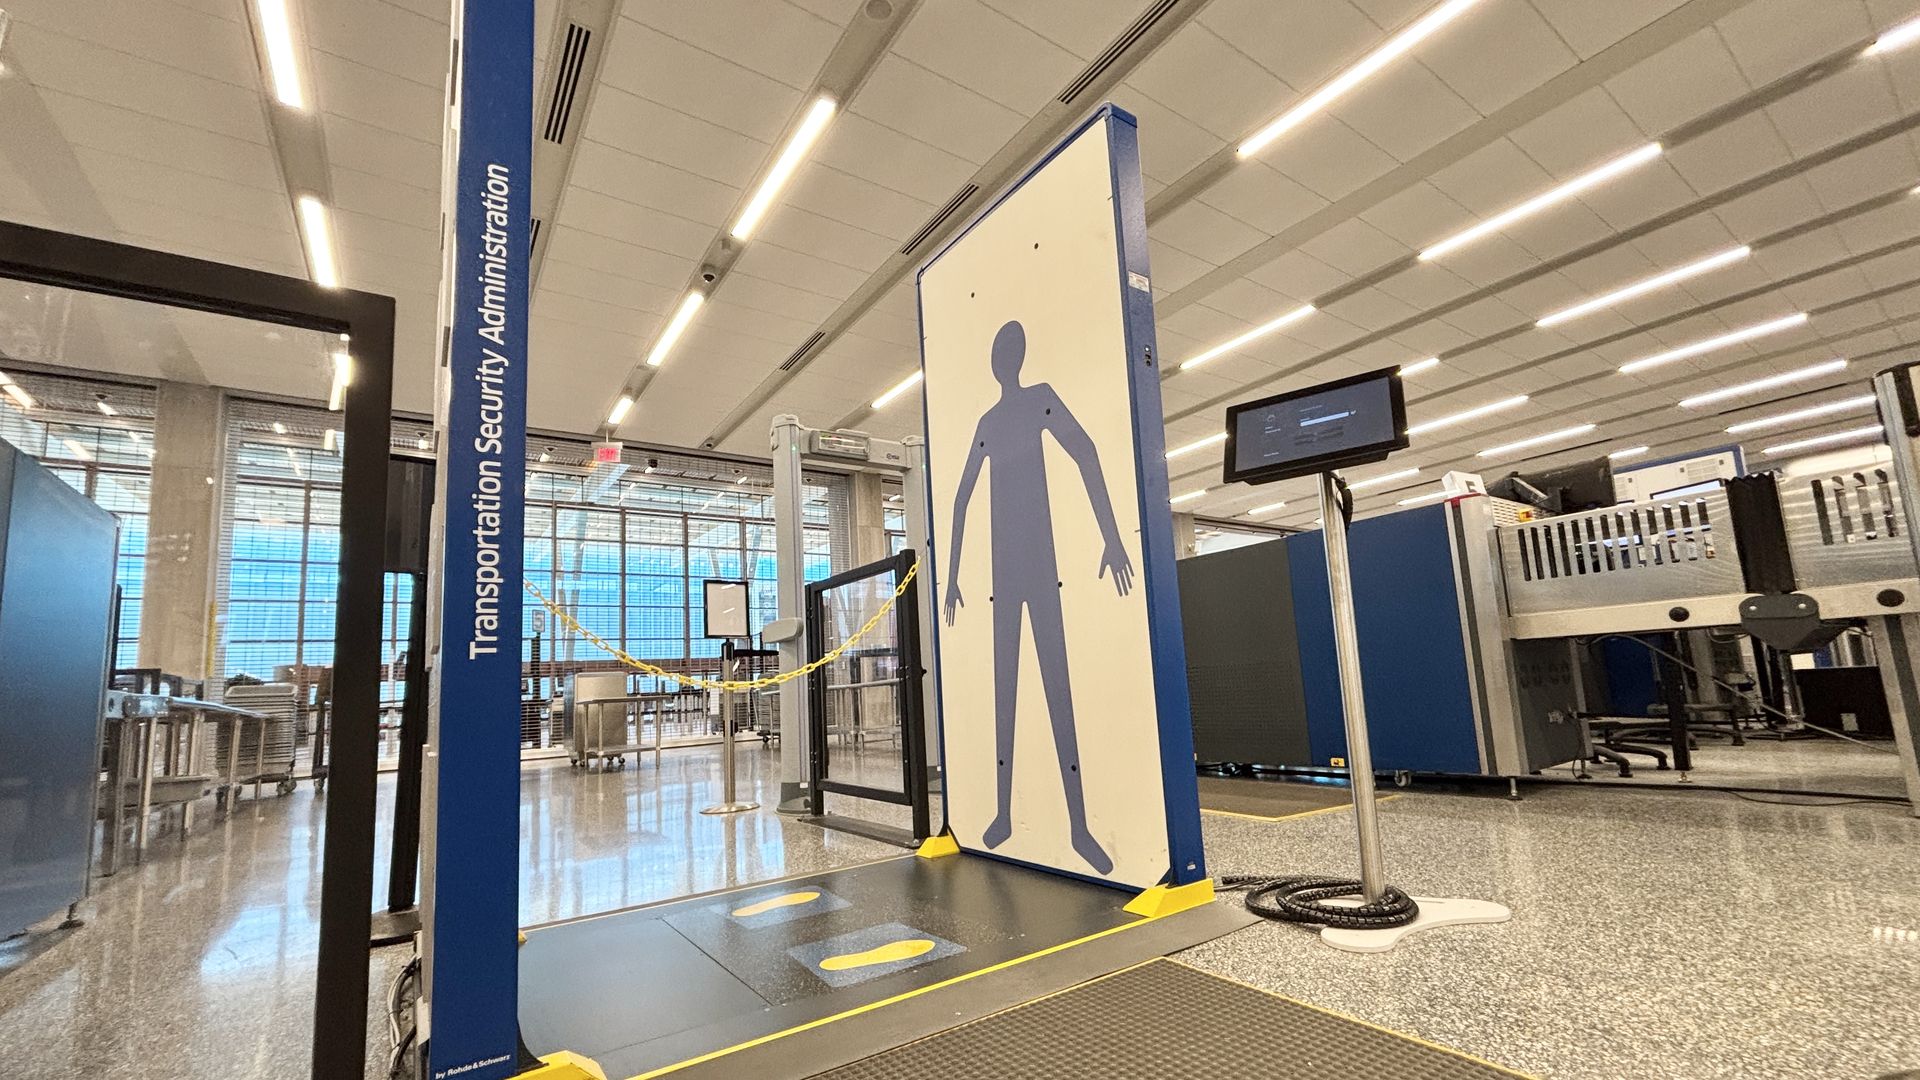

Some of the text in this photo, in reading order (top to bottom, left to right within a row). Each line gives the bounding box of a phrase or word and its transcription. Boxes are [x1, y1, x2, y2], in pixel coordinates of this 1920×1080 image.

[469, 163, 509, 660] Transportation Security Administration
